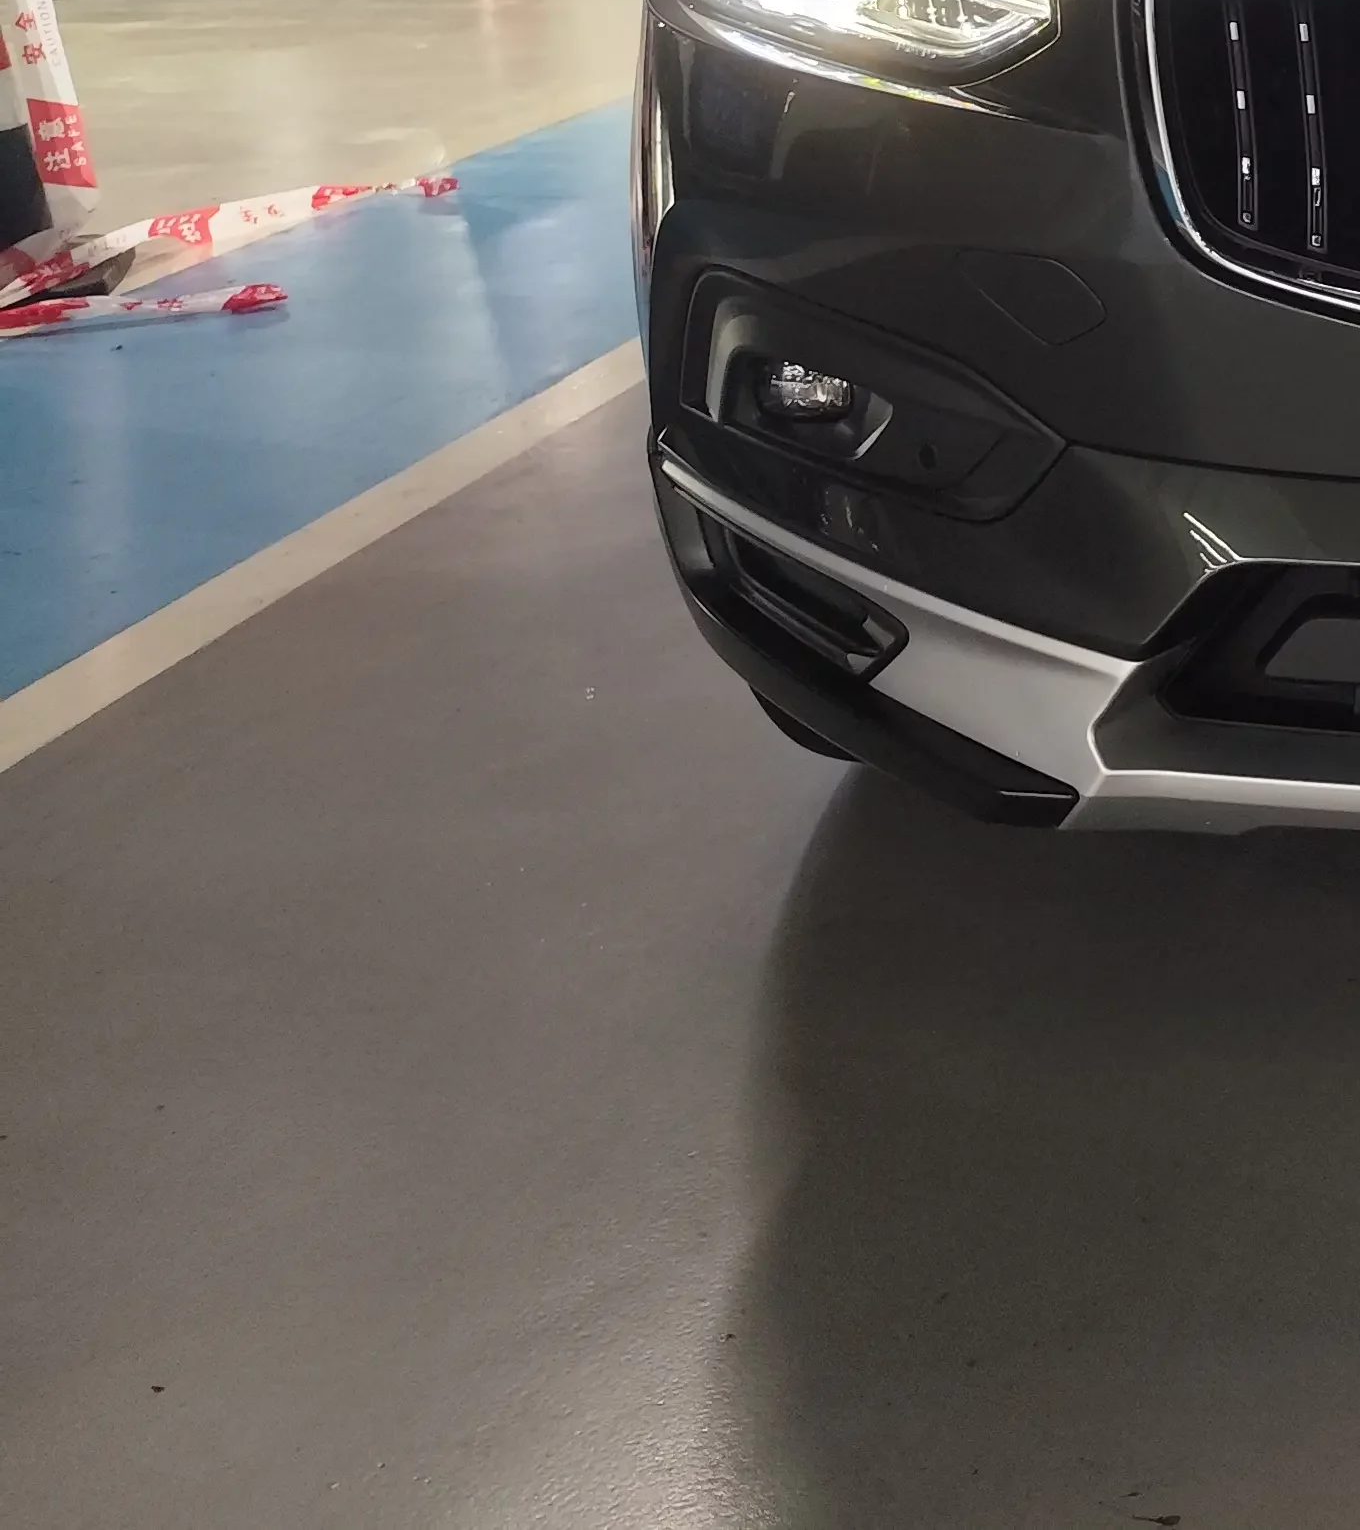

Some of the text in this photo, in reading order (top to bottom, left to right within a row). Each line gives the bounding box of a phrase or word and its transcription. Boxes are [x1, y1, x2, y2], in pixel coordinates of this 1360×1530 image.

[15, 11, 46, 65] 安全
[38, 117, 71, 172] 注意
[64, 113, 87, 167] SAFE
